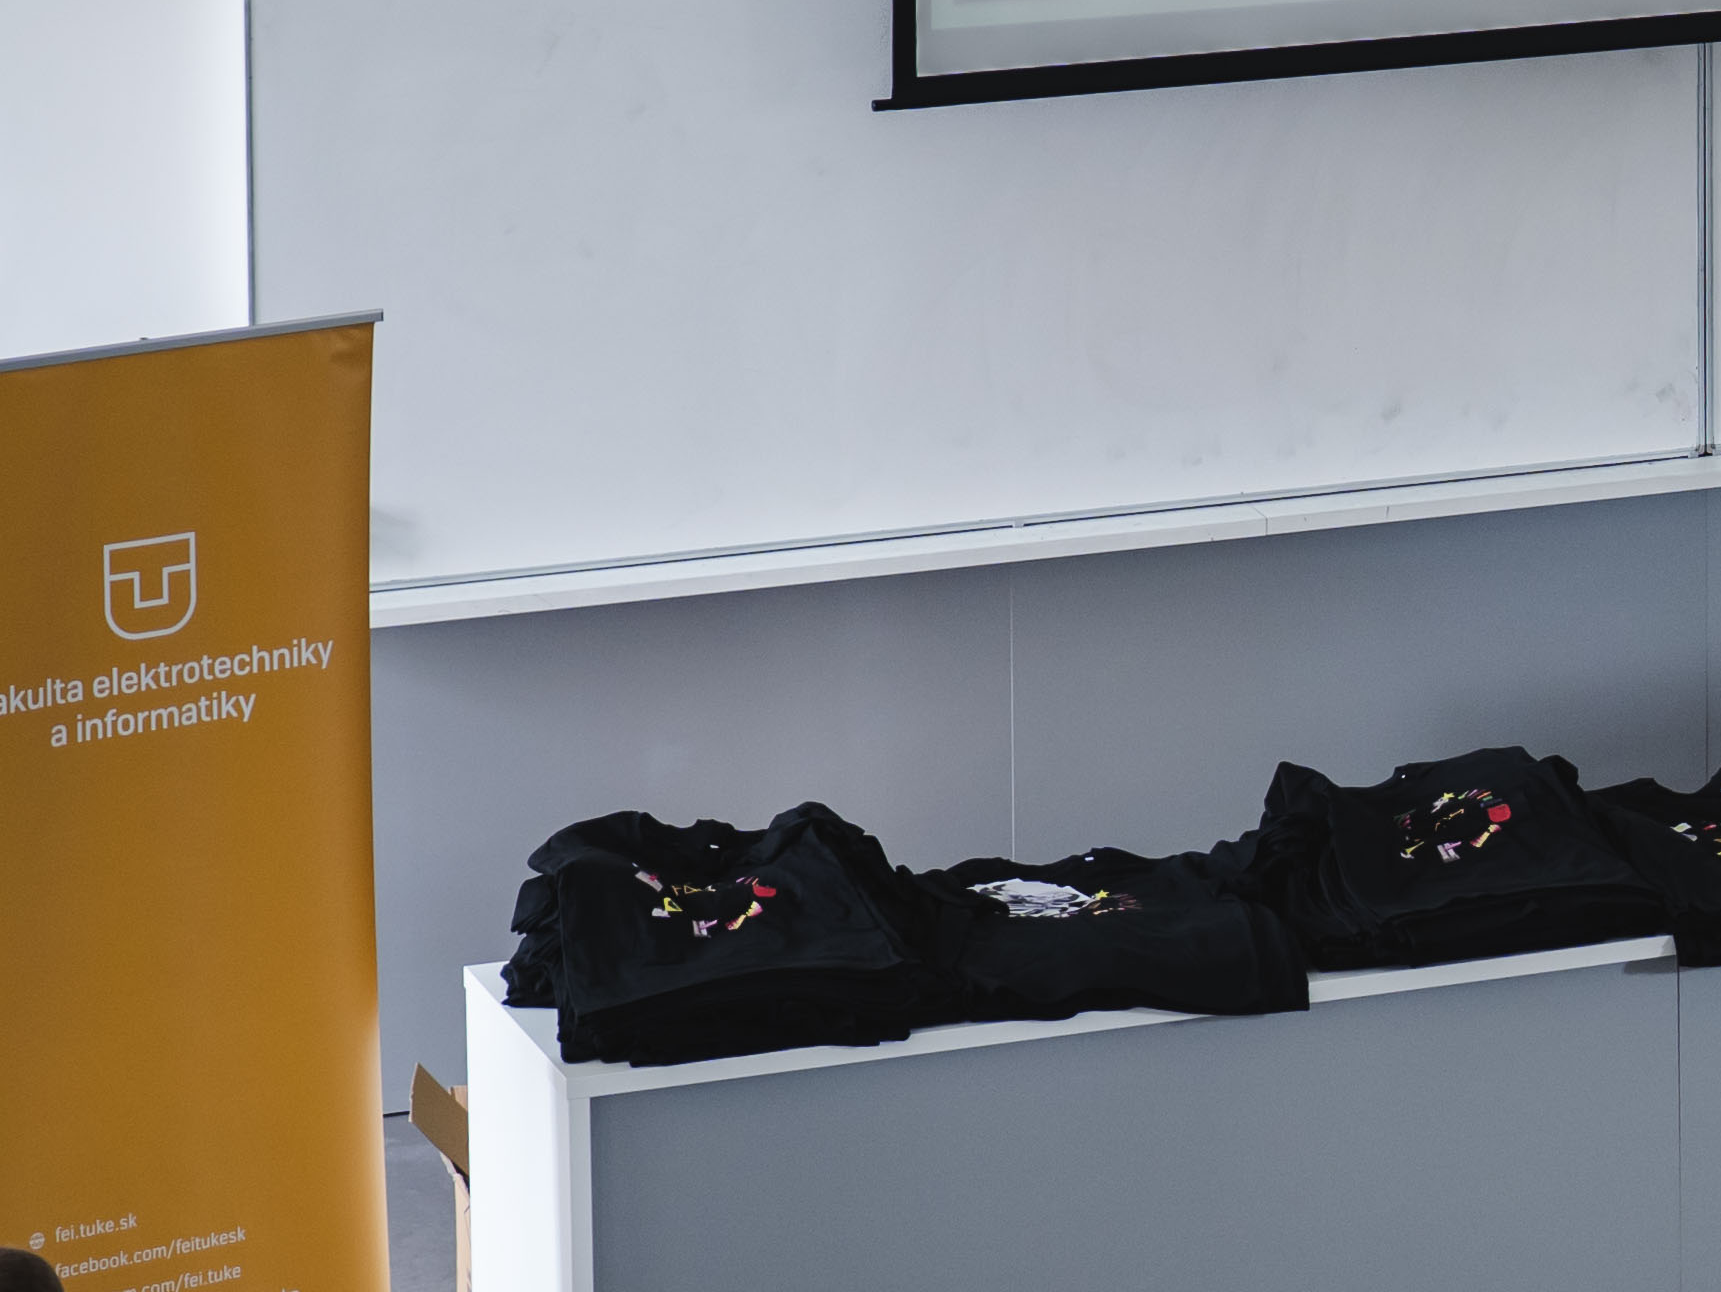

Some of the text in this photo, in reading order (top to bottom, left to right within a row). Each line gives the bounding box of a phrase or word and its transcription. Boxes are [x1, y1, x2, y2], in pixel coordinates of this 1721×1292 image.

[92, 637, 334, 699] elektrotechniky
[50, 690, 257, 747] a informatiky
[55, 1212, 138, 1243] fei.tuke.sk
